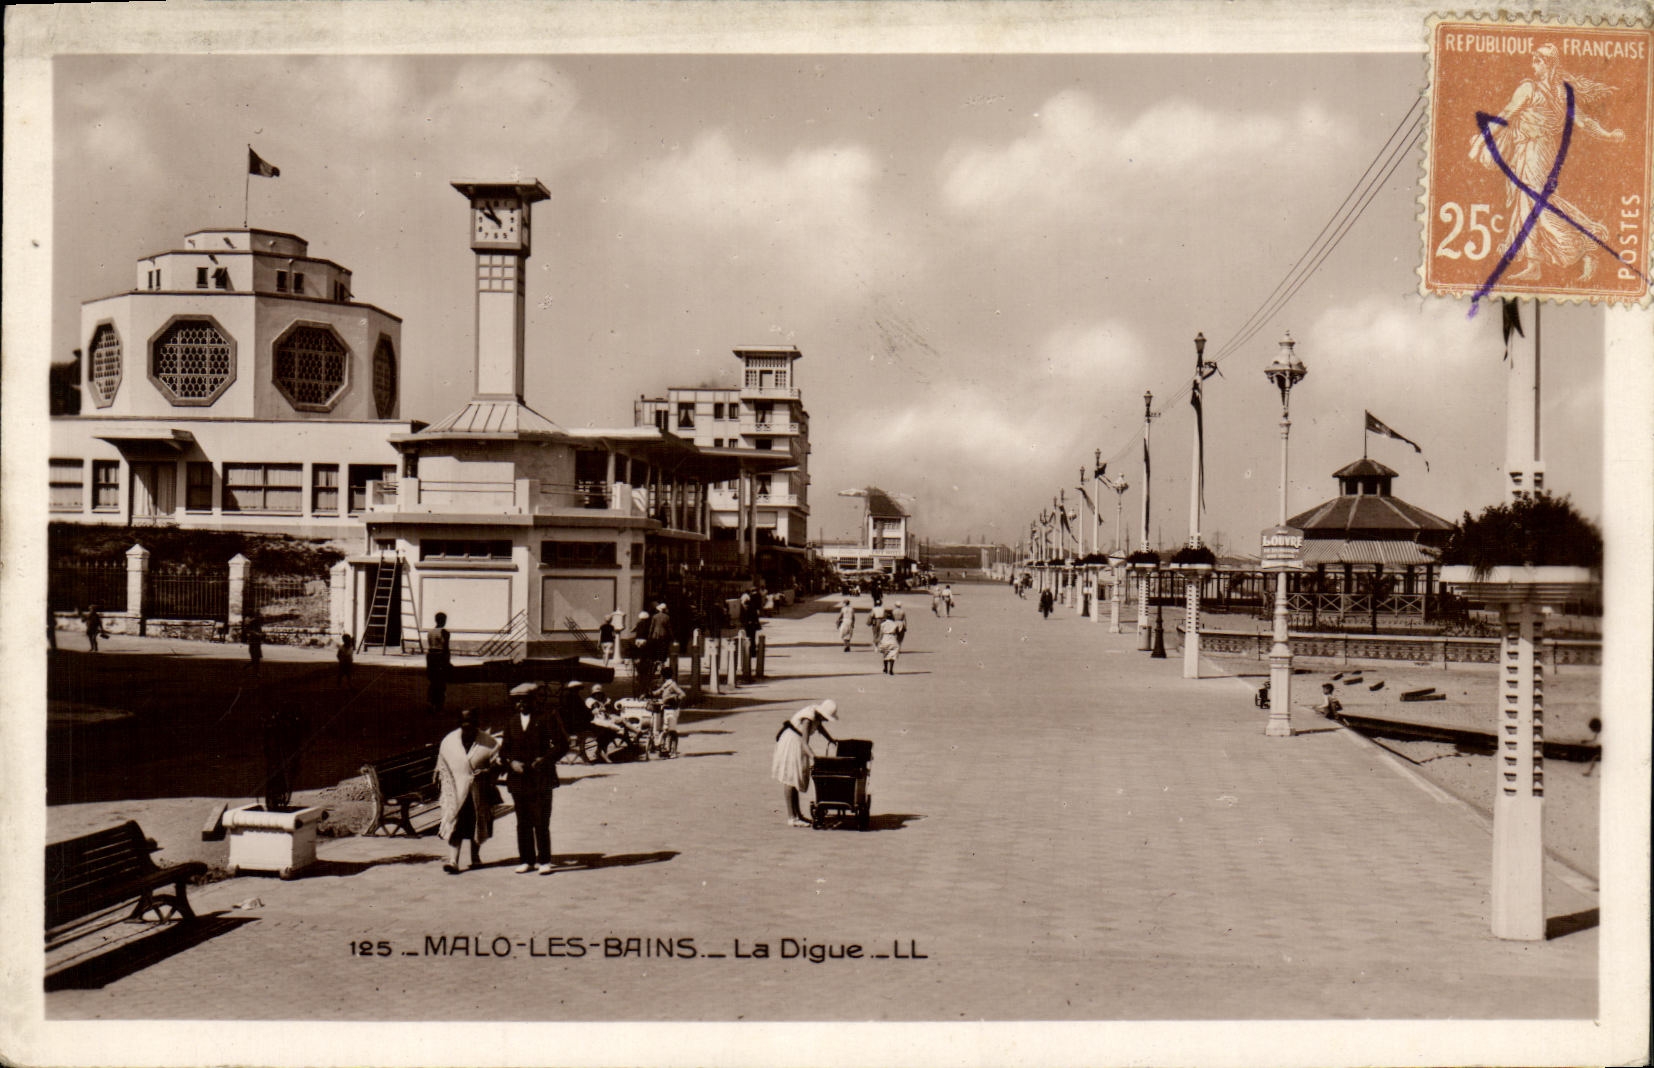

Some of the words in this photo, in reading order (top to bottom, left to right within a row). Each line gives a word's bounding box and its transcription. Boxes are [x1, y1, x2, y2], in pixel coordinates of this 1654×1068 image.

[1563, 38, 1645, 60] FRANÇAISE
[1617, 194, 1641, 281] POSTES
[1262, 535, 1303, 549] LOUVRE
